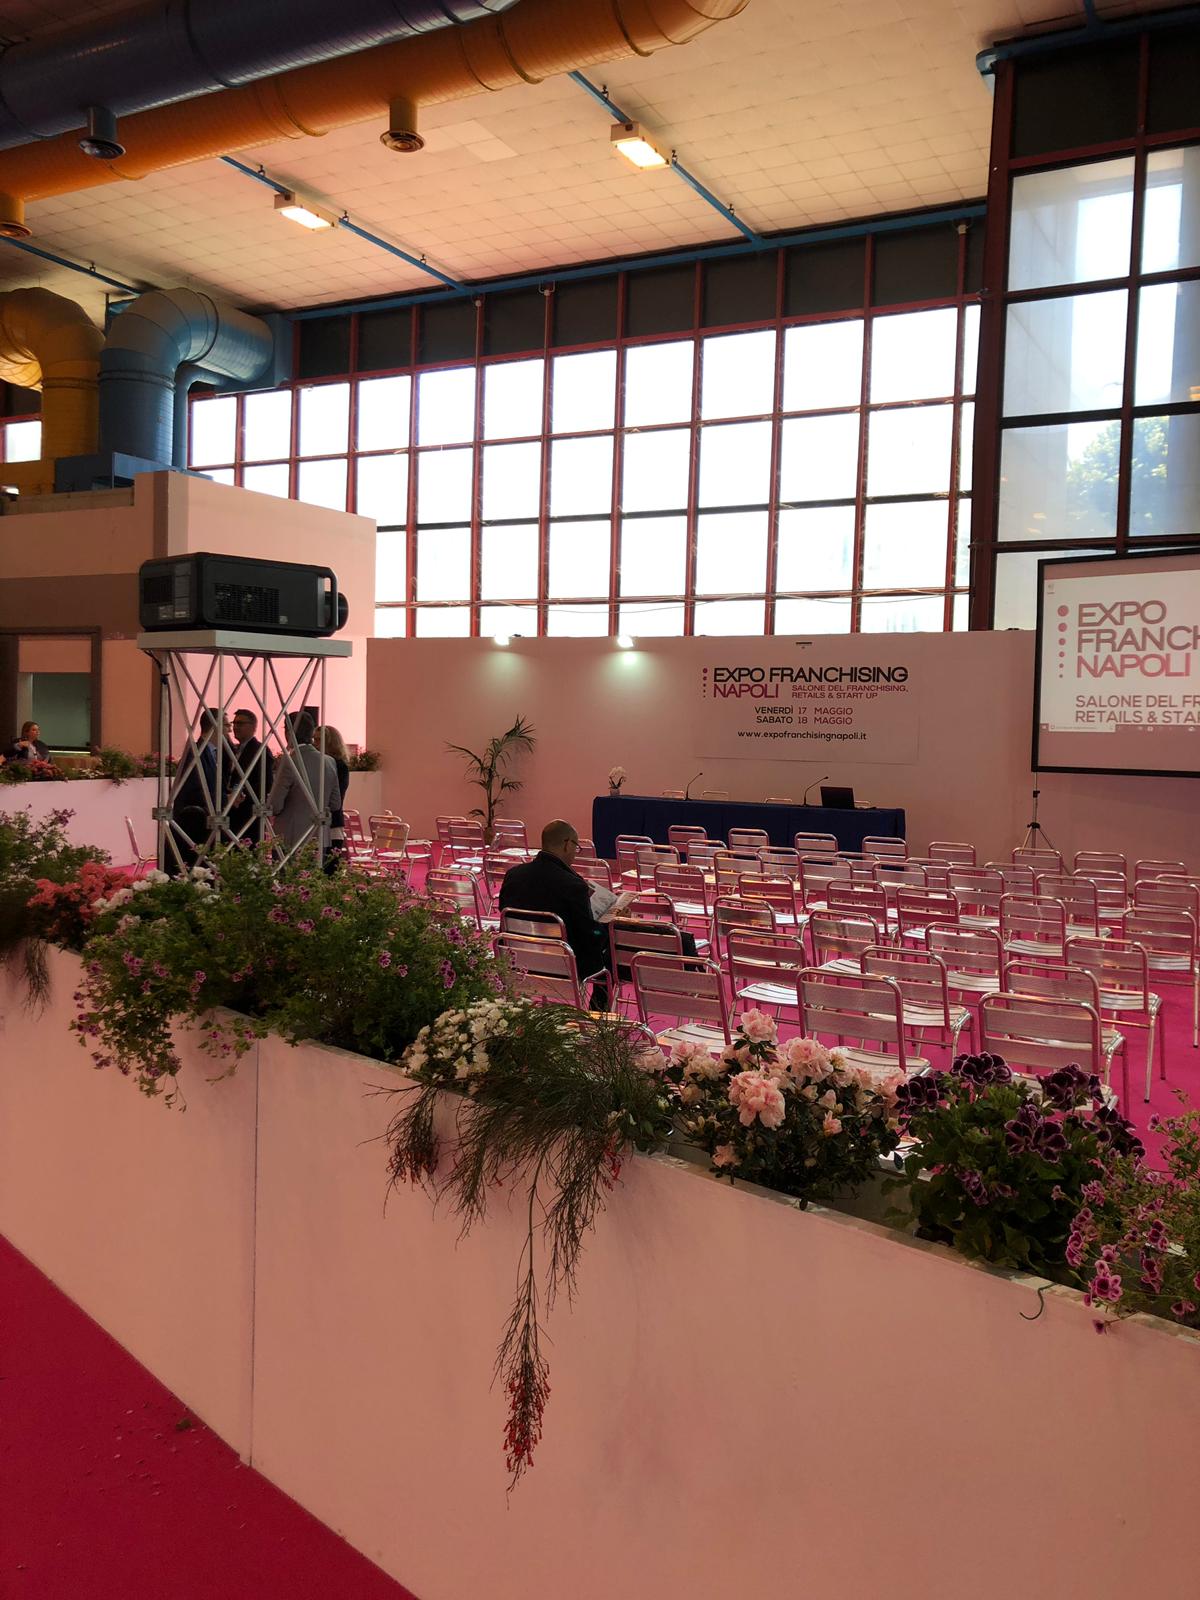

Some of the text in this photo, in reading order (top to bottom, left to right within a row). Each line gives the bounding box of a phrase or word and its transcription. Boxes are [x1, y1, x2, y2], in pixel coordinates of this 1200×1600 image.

[1078, 600, 1167, 627] EXPO
[1076, 653, 1191, 678] NAPOLI
[714, 666, 908, 682] EXPO FRANCHISING
[713, 684, 778, 698] NAPOLI
[1075, 695, 1142, 708] SALONE
[1146, 695, 1178, 708] DEL
[754, 705, 793, 714] VENERDÌ
[814, 707, 853, 715] MAGGIO
[1075, 710, 1200, 723] RETAILS & STA
[756, 716, 793, 724] SABATO
[814, 717, 852, 725] MAGGIO
[738, 731, 867, 741] www.expofranchisingnapoli.it
